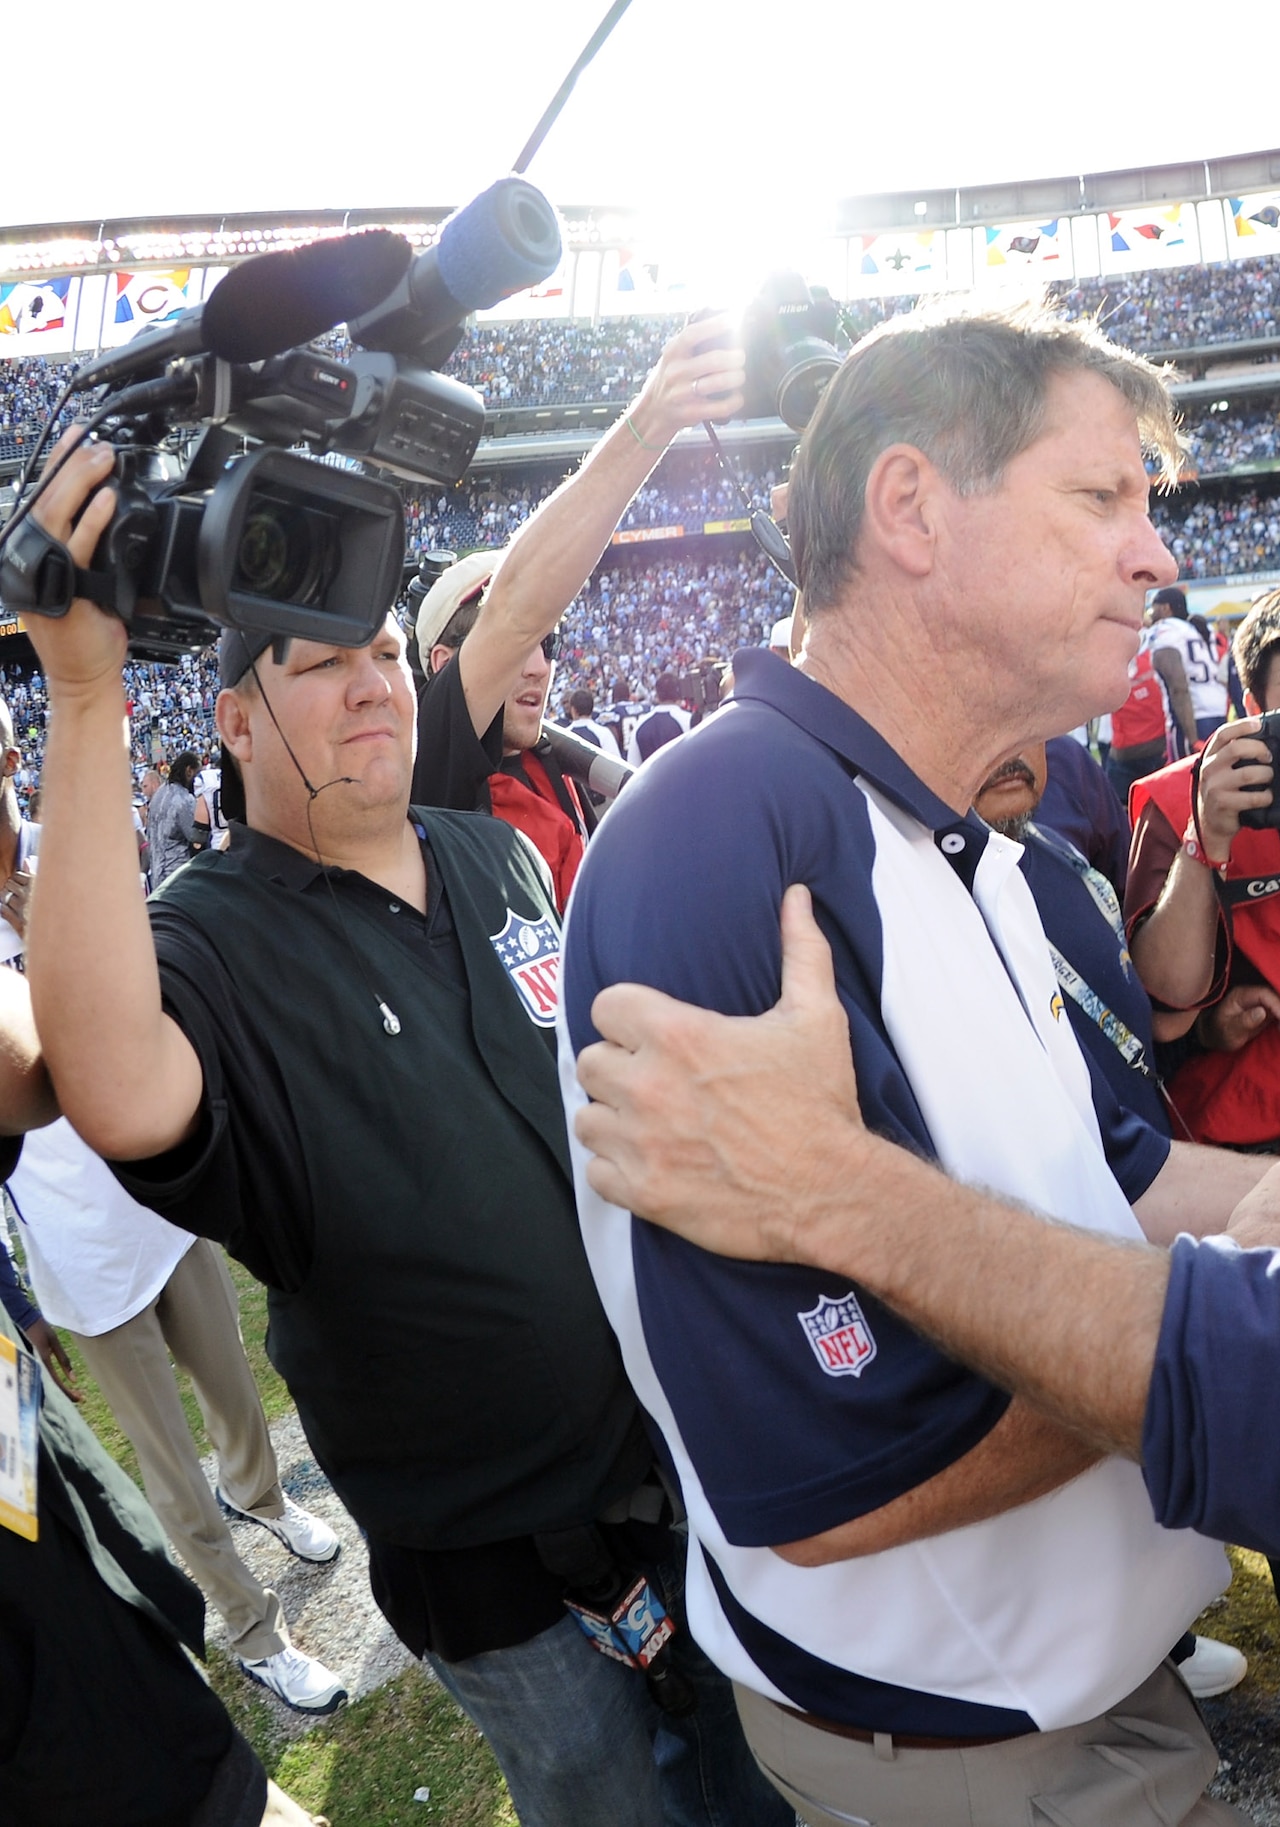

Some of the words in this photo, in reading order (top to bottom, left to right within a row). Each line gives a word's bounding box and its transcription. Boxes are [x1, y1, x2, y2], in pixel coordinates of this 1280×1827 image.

[778, 304, 809, 314] Nikon
[318, 371, 341, 386] SONY
[619, 526, 678, 544] CYMER
[819, 1326, 869, 1367] NFL
[626, 1599, 656, 1642] 5
[640, 1621, 672, 1665] FOX
